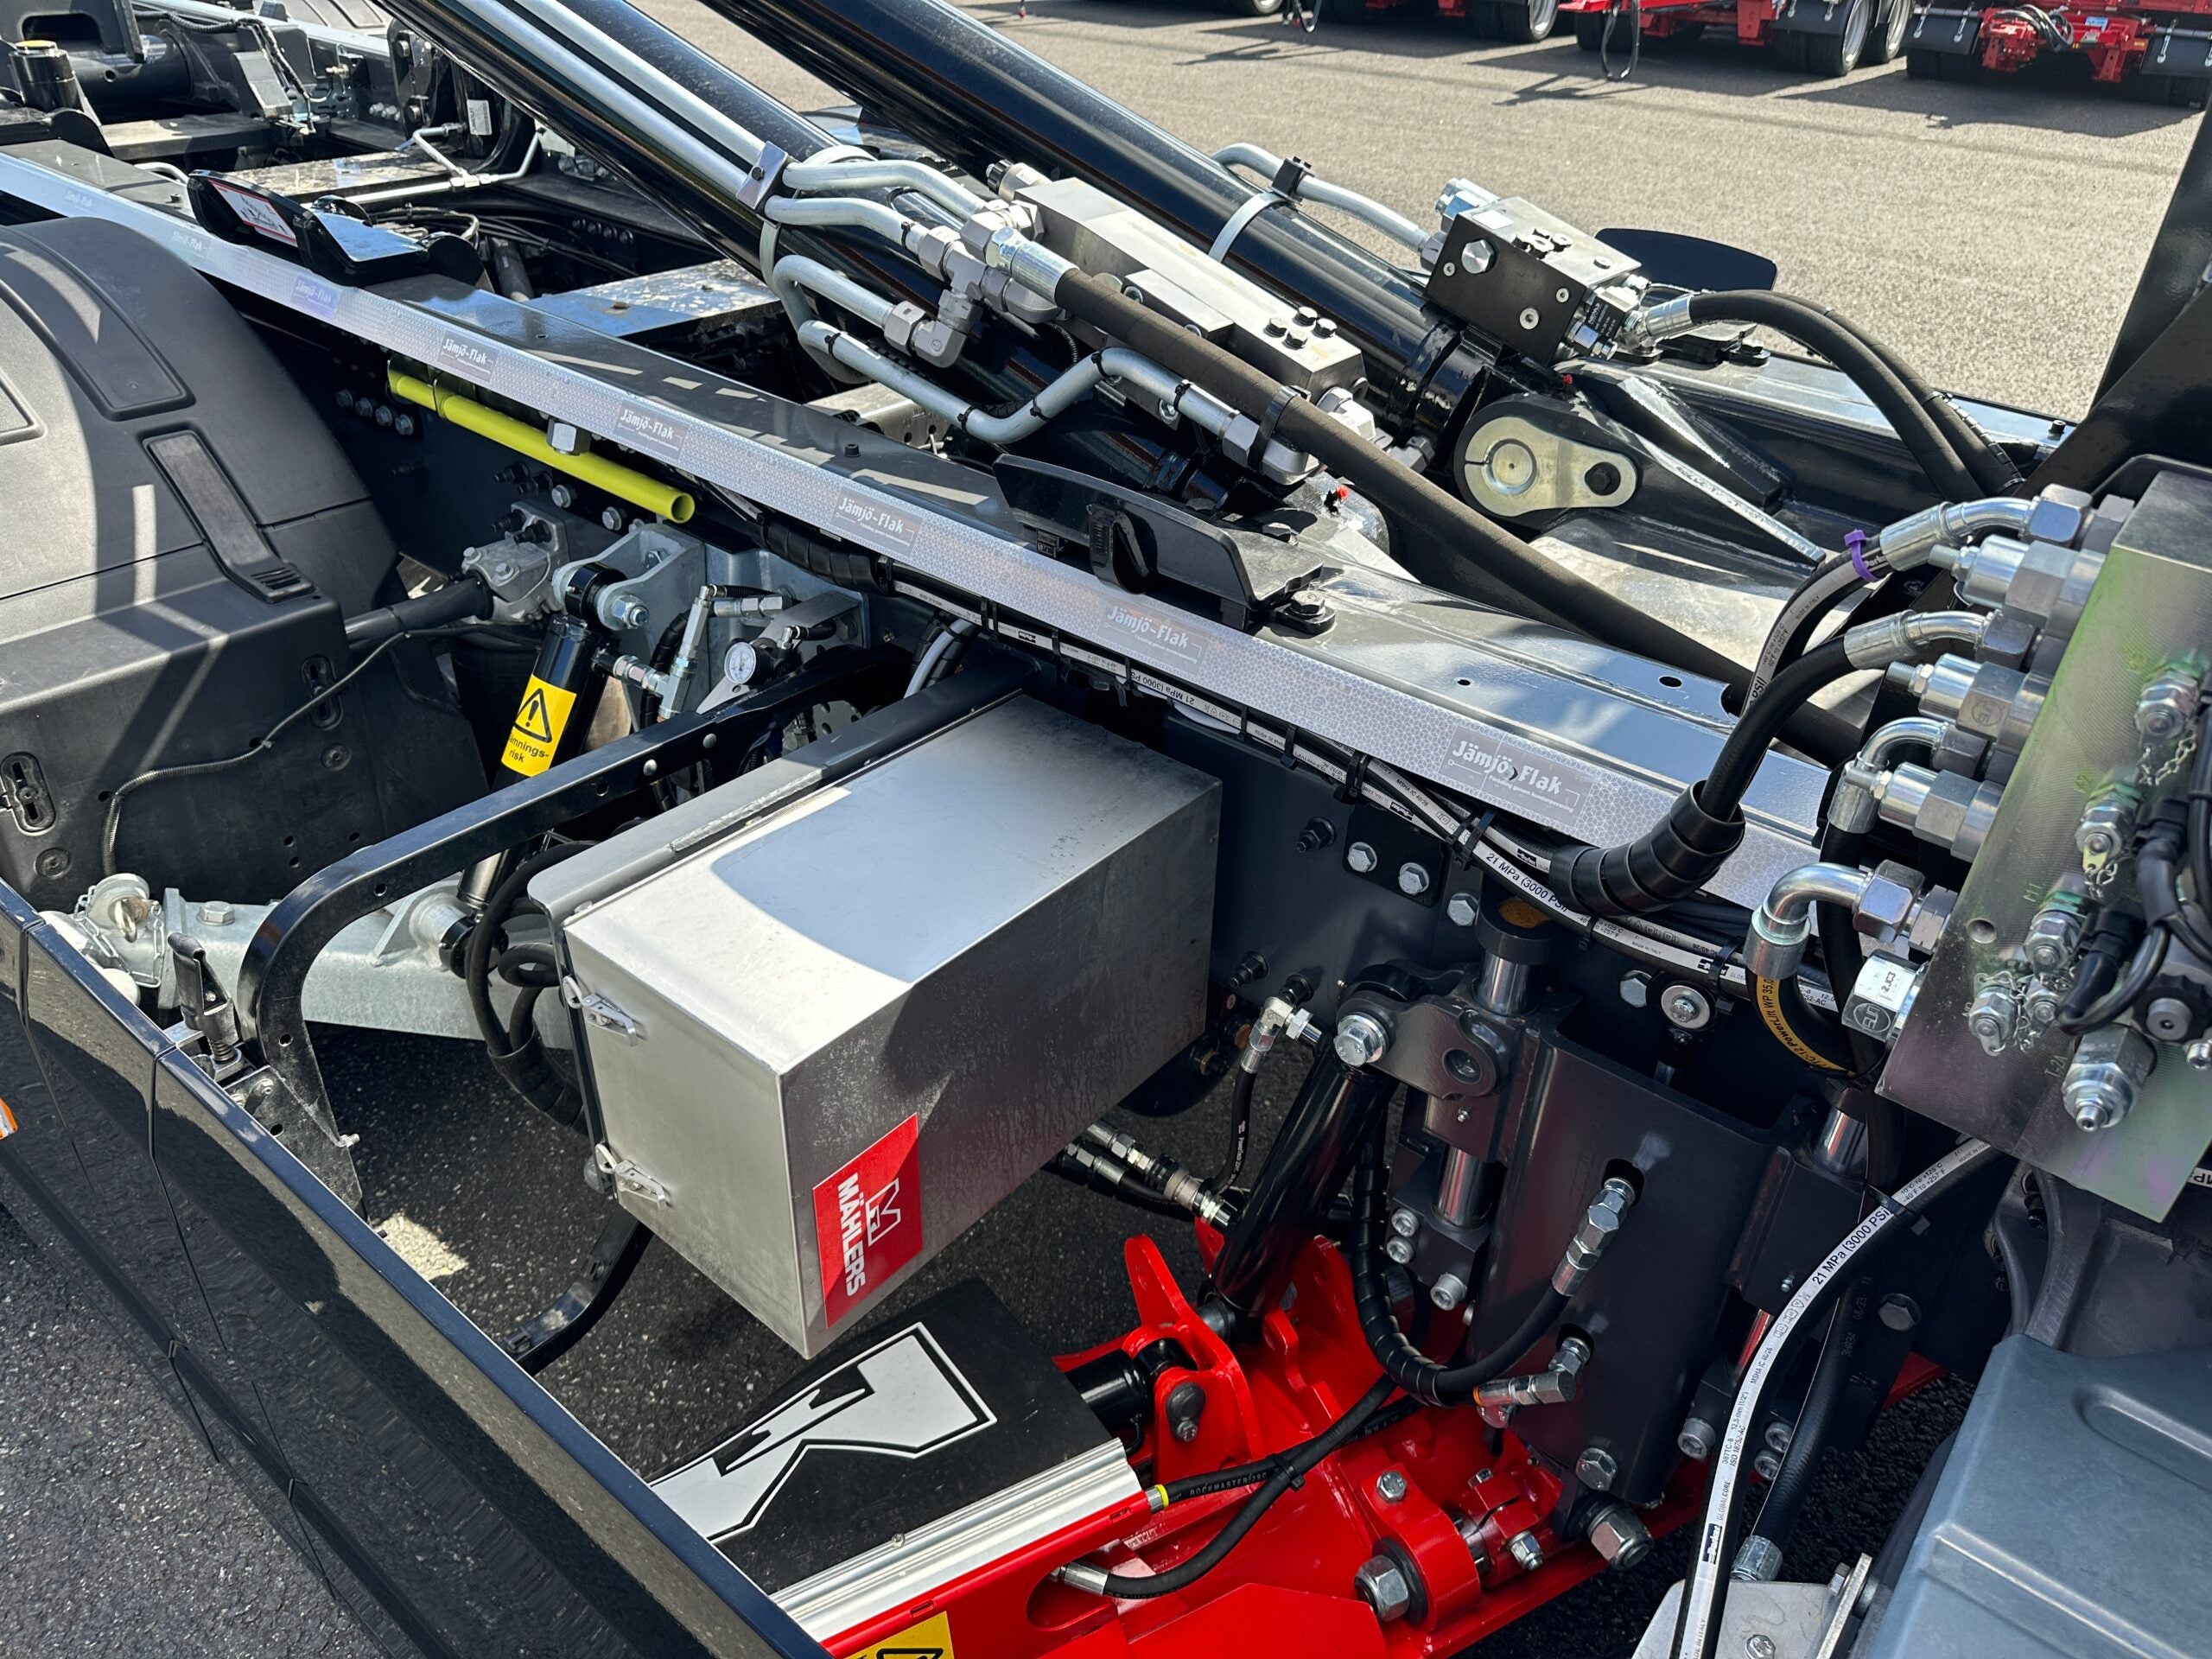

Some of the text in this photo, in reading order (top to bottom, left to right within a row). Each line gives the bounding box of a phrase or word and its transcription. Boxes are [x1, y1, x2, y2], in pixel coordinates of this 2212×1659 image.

[442, 338, 487, 365] Jämjö-Flak
[620, 409, 674, 441] Jämjö-Flak
[838, 497, 905, 534] Jämjö-Flak
[1107, 605, 1190, 650] Jämjö-Flak
[509, 734, 550, 758] ämnings-
[509, 748, 525, 763] risk
[1452, 740, 1562, 795] JämjöFlak
[1486, 852, 1497, 865] 21
[1498, 861, 1521, 881] MPa
[1521, 876, 1548, 899] (3000
[1763, 995, 1775, 1010] WP
[837, 1172, 867, 1297] MÄHLERS
[1812, 1271, 1827, 1286] 21
[1821, 1250, 1847, 1273] MPa
[1841, 1224, 1872, 1252] (3000
[1704, 1480, 1731, 1564] Parker GLOBALCORE
